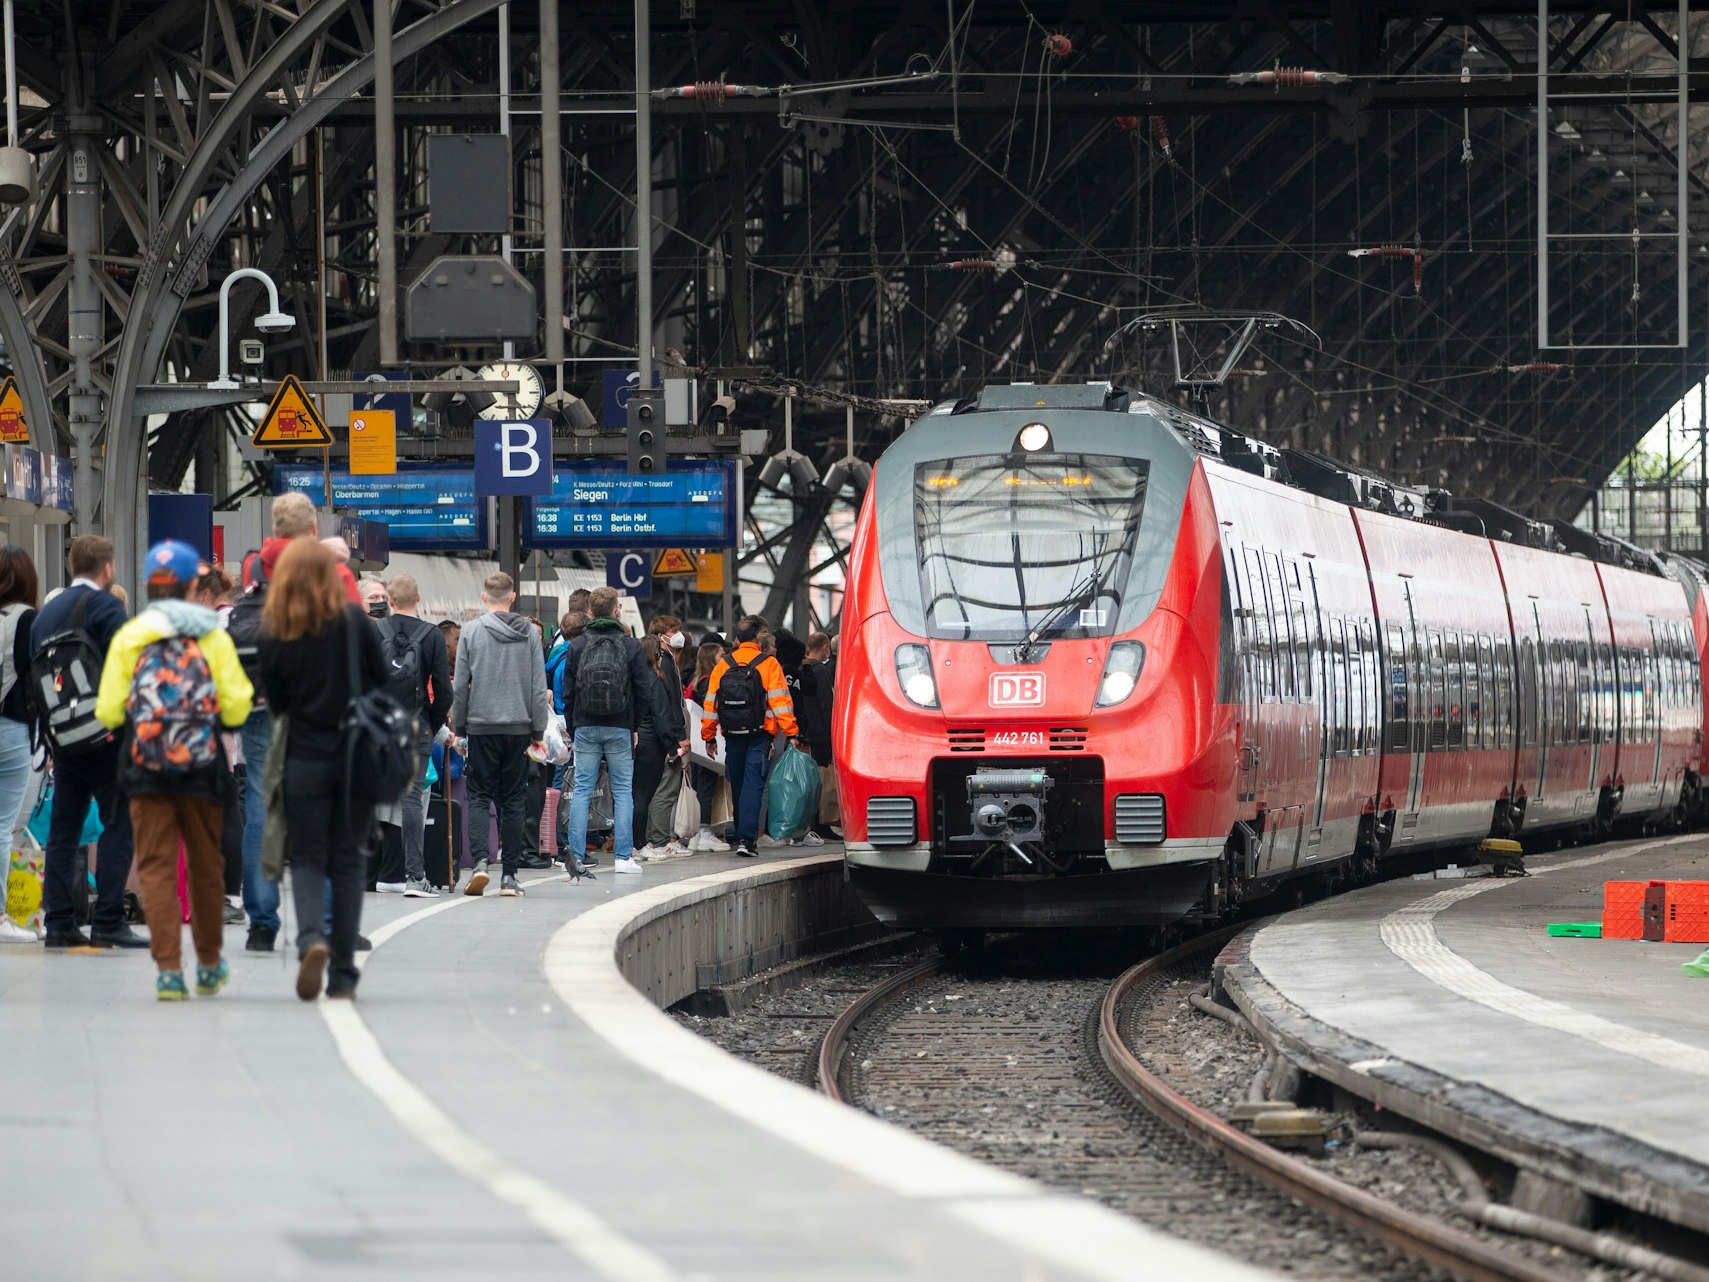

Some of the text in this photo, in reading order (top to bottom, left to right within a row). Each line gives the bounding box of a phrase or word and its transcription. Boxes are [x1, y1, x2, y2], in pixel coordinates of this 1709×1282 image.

[501, 423, 540, 477] B
[335, 491, 379, 499] Oberbarmen
[574, 489, 608, 502] Siegen
[537, 514, 557, 522] 16:38
[611, 524, 632, 532] Berlin
[634, 524, 657, 532] Ostbf.
[620, 553, 644, 588] C
[997, 678, 1038, 701] DB
[994, 731, 1043, 744] 442 761
